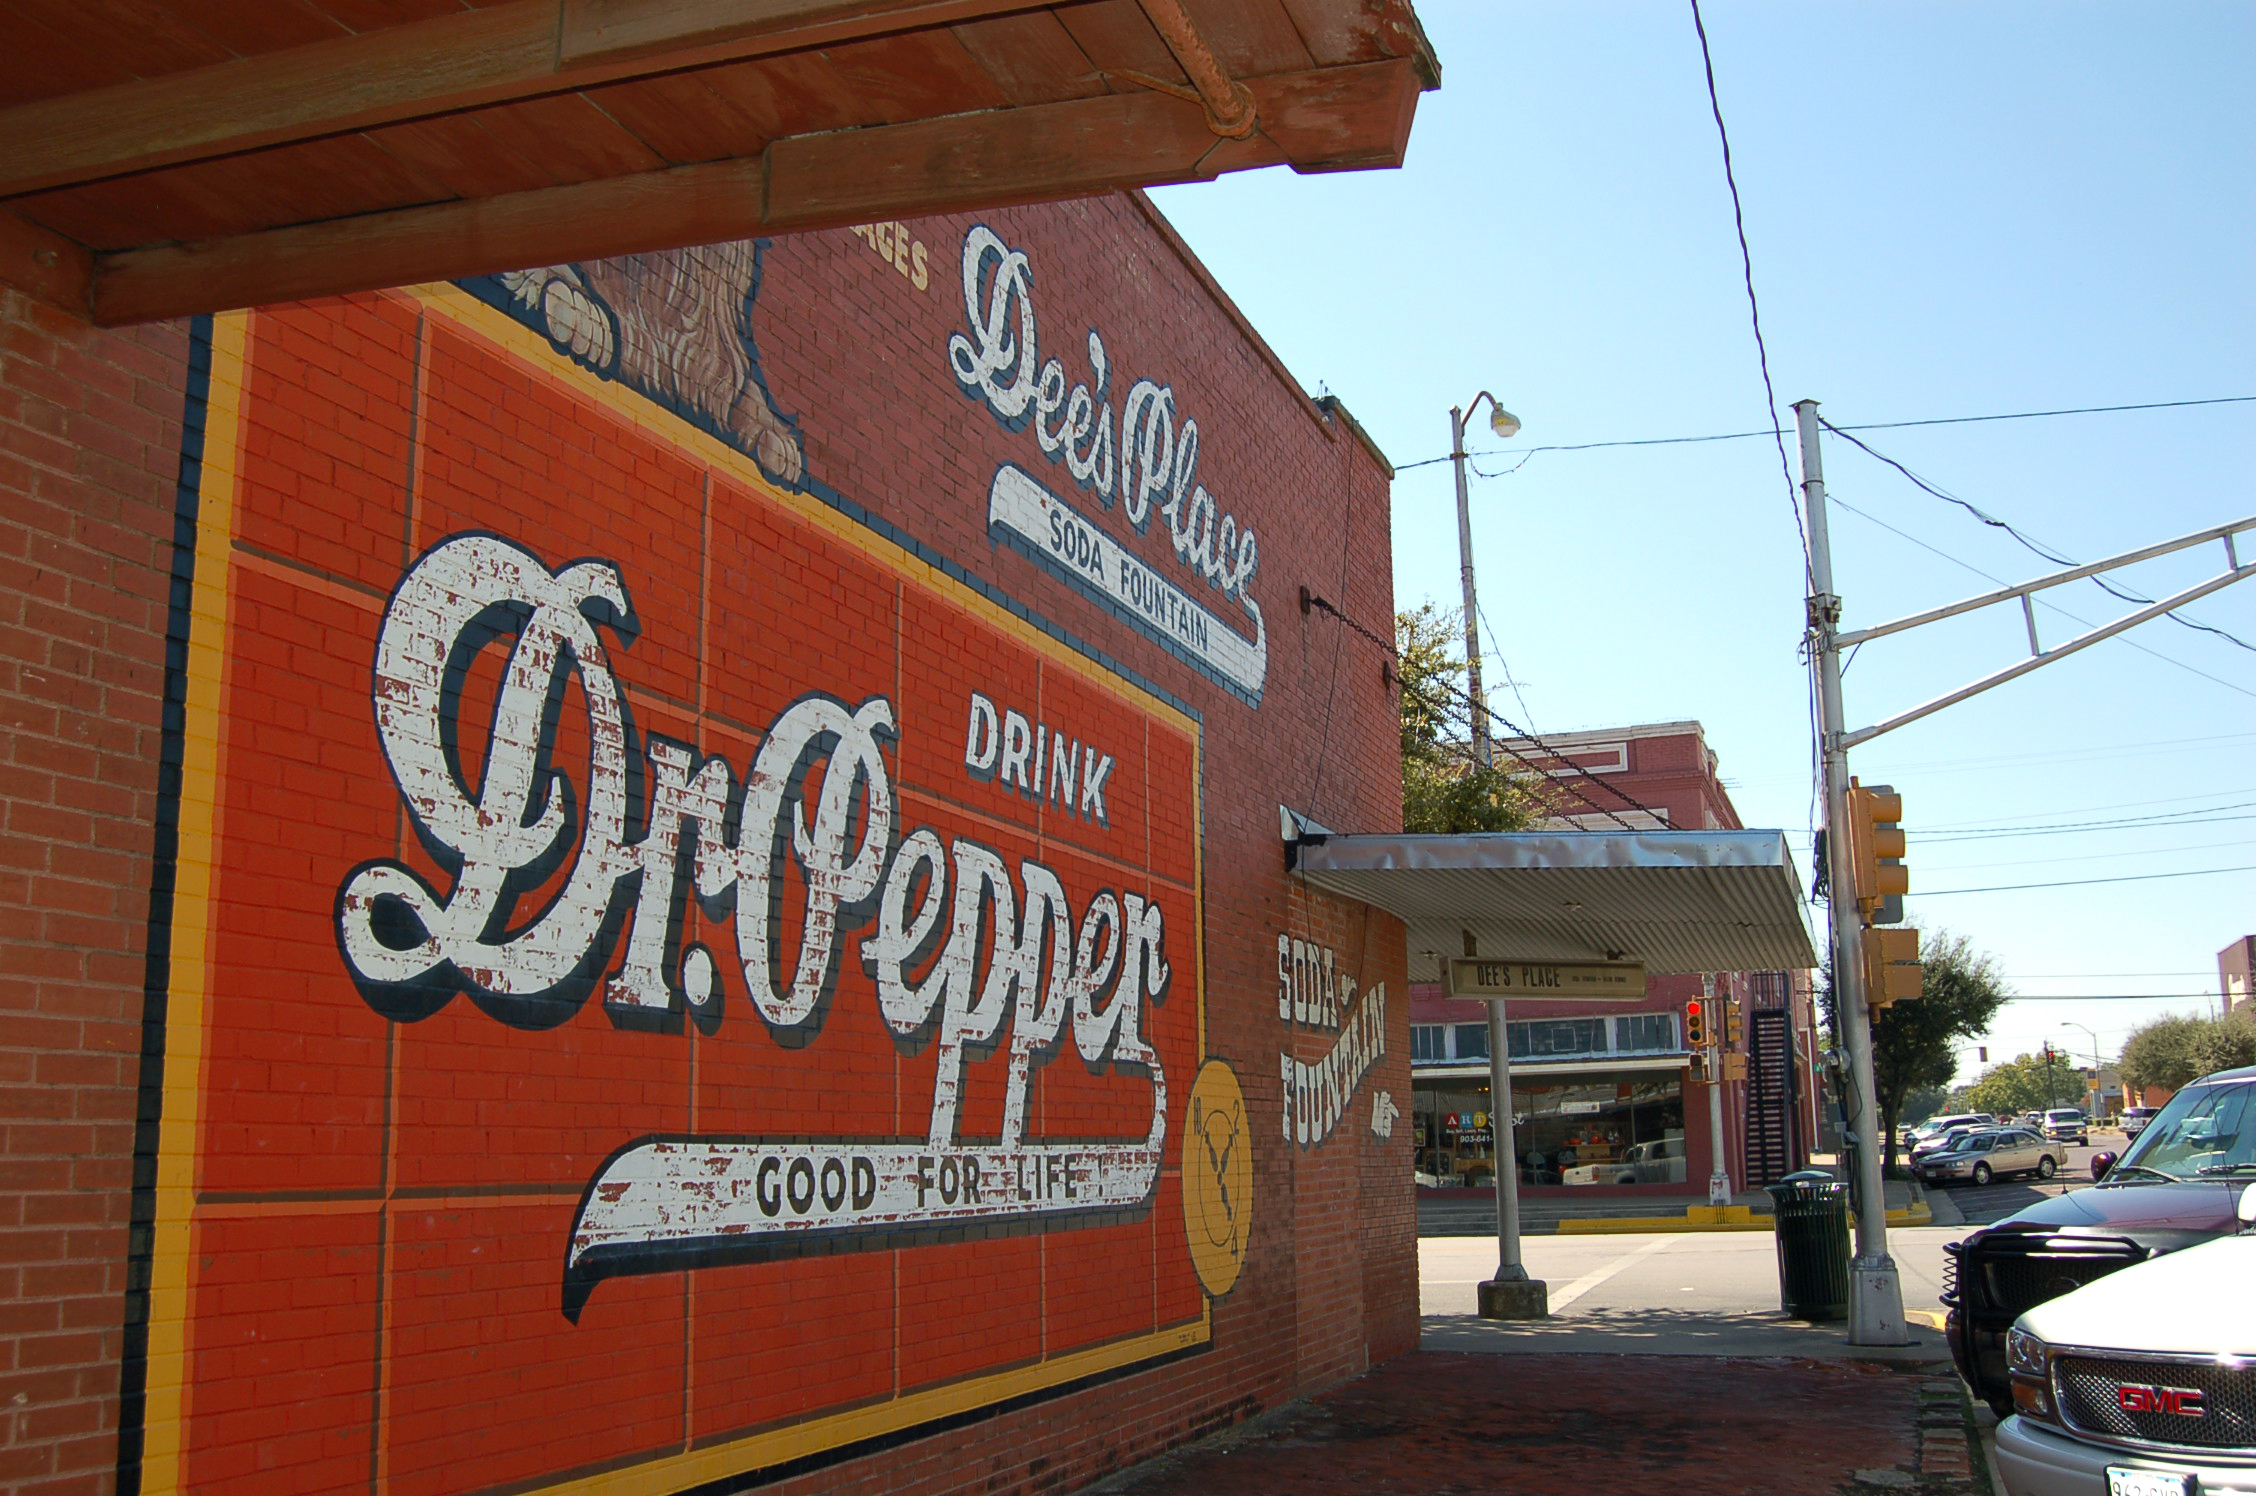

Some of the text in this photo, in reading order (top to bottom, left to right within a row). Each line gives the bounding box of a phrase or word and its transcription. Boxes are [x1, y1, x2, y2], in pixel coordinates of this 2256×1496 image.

[949, 225, 1259, 594] Dee's Place
[1048, 508, 1209, 652] SODA FOUNTAIN
[965, 692, 1111, 818] DRINK
[340, 533, 1170, 1148] Dr. Pepper
[1278, 933, 1338, 1028] SODA
[1477, 965, 1561, 989] DEE'S PLACE
[1280, 980, 1386, 1144] FOUNTAIN
[1233, 1099, 1240, 1136] 2
[1446, 1113, 1486, 1125] ART
[756, 1156, 877, 1218] GOOD
[917, 1154, 983, 1209] FOR
[1231, 1227, 1239, 1264] 4
[2118, 1382, 2204, 1417] GMC
